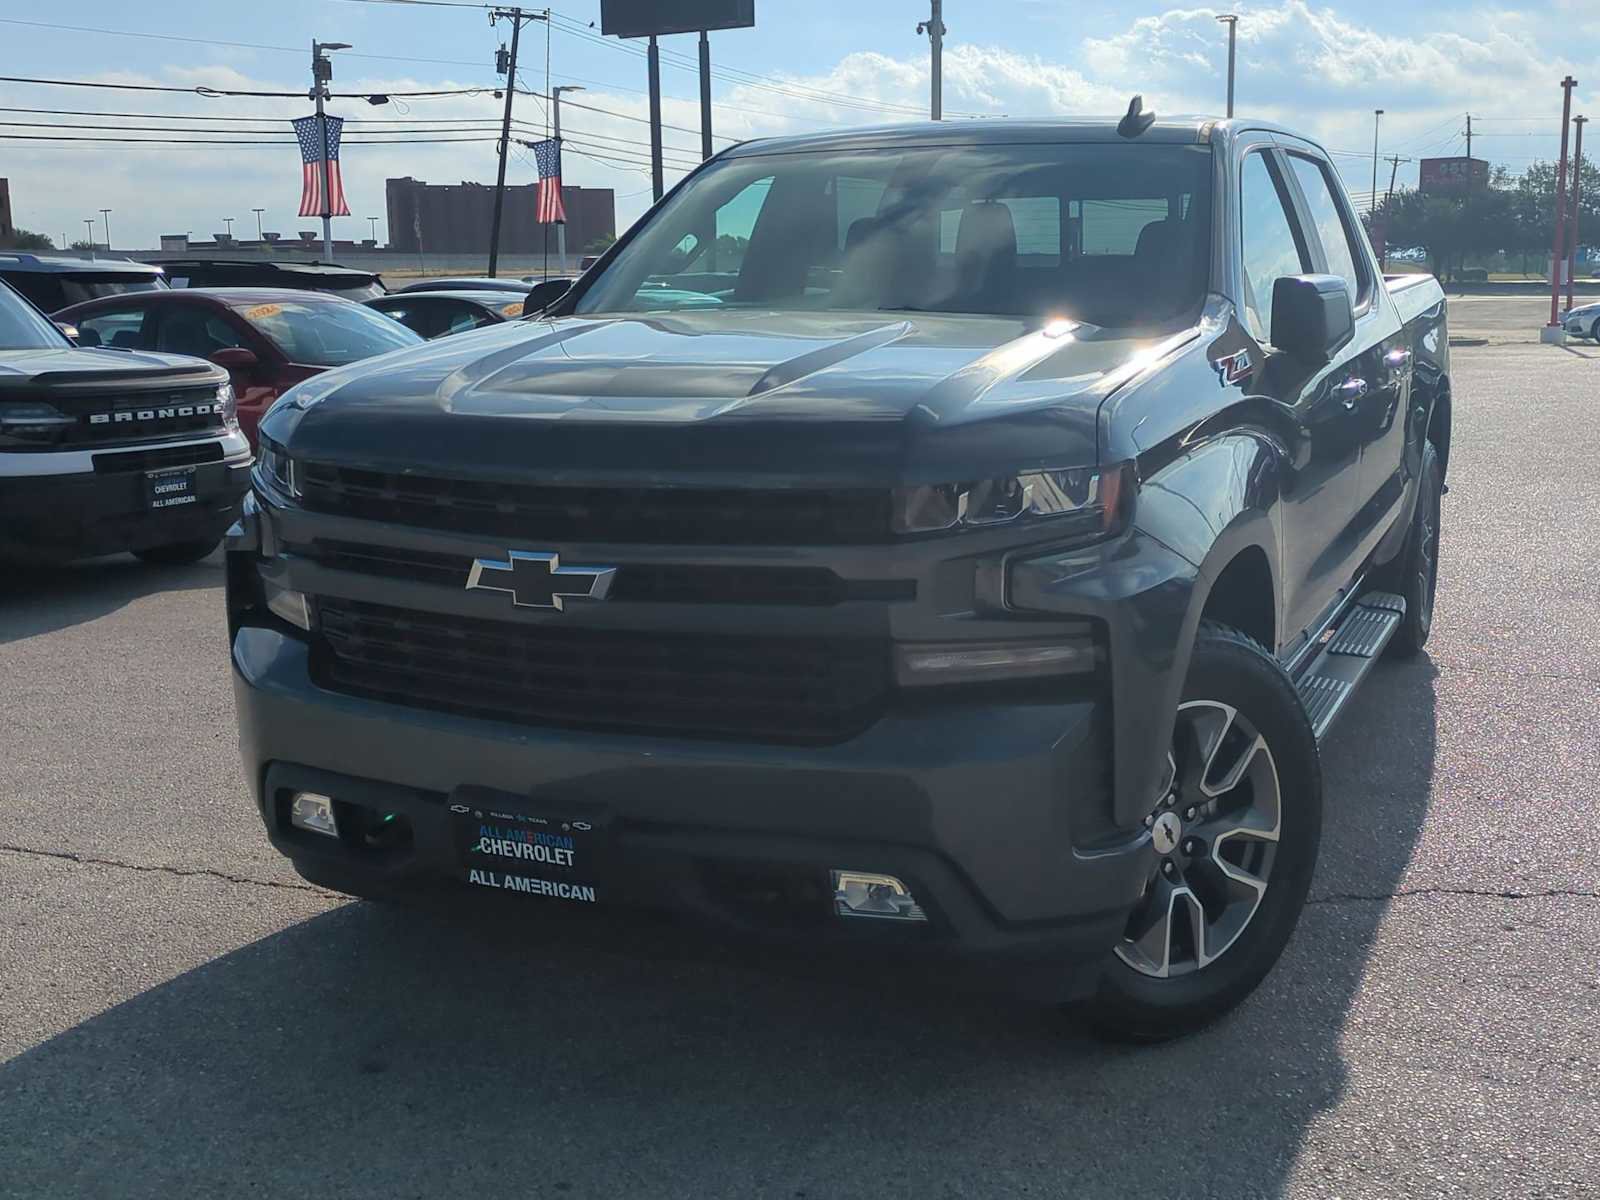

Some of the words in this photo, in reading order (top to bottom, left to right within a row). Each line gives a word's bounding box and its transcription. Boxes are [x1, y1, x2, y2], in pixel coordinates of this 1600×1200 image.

[89, 406, 211, 424] BRONCO
[480, 825, 502, 838] ALL
[506, 829, 574, 849] AMERICAN
[480, 837, 575, 867] CHEVROLET
[469, 869, 501, 888] ALL
[504, 875, 596, 902] AMERICAN
